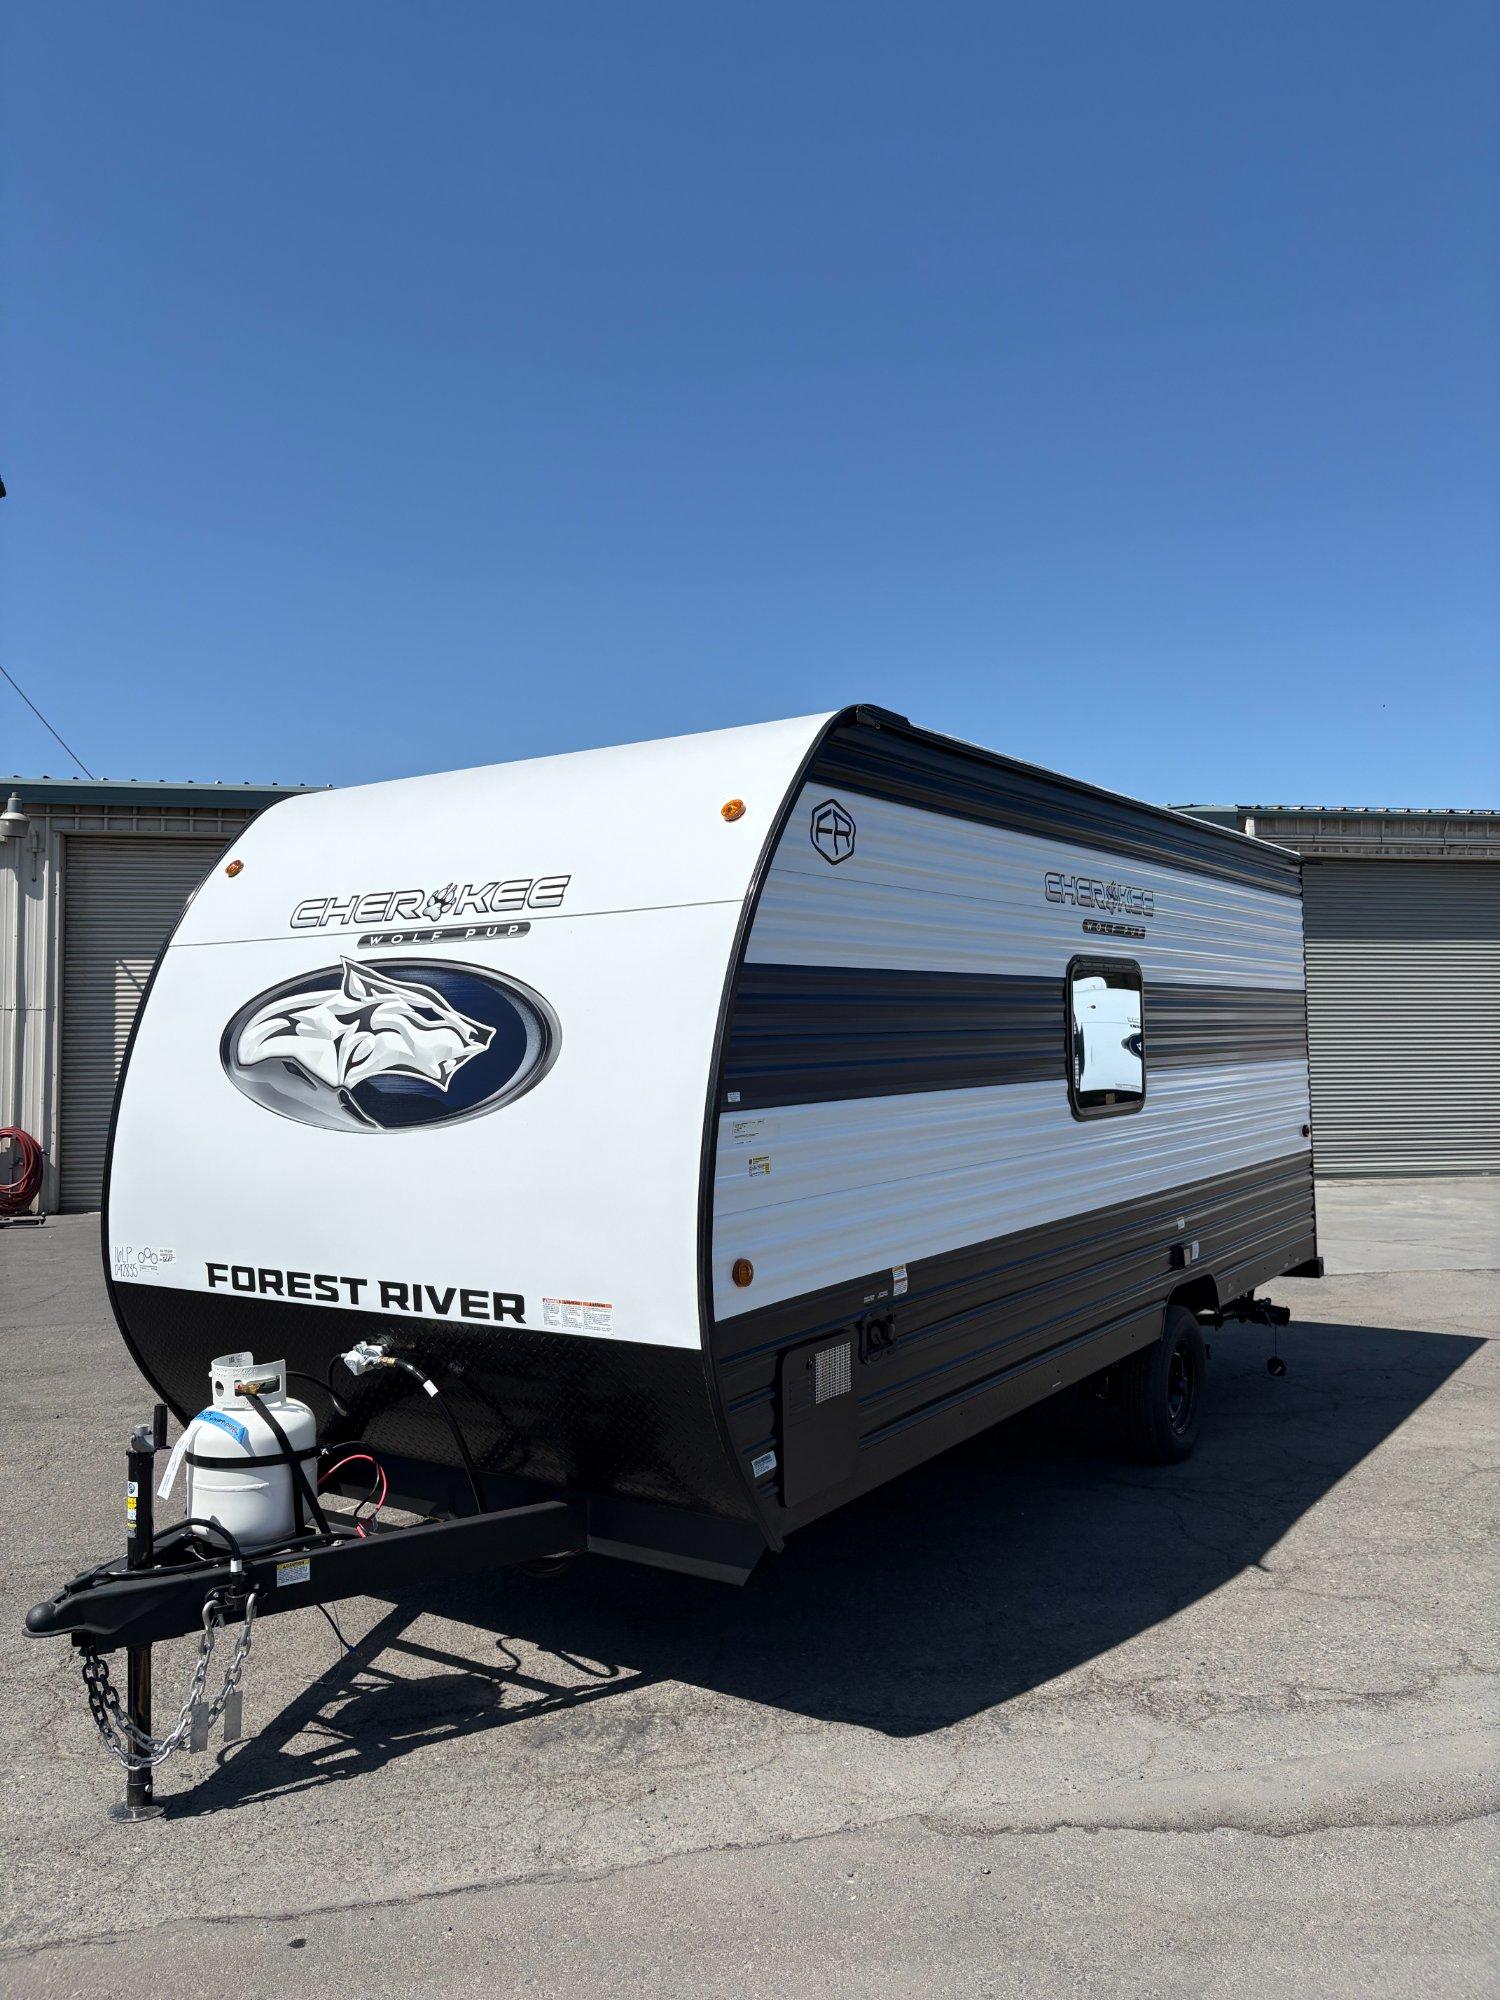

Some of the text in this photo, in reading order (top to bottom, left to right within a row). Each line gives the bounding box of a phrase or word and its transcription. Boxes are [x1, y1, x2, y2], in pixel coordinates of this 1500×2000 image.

[369, 924, 520, 946] WOLF PUP
[205, 1262, 368, 1306] FOREST
[377, 1280, 527, 1325] RIVER
